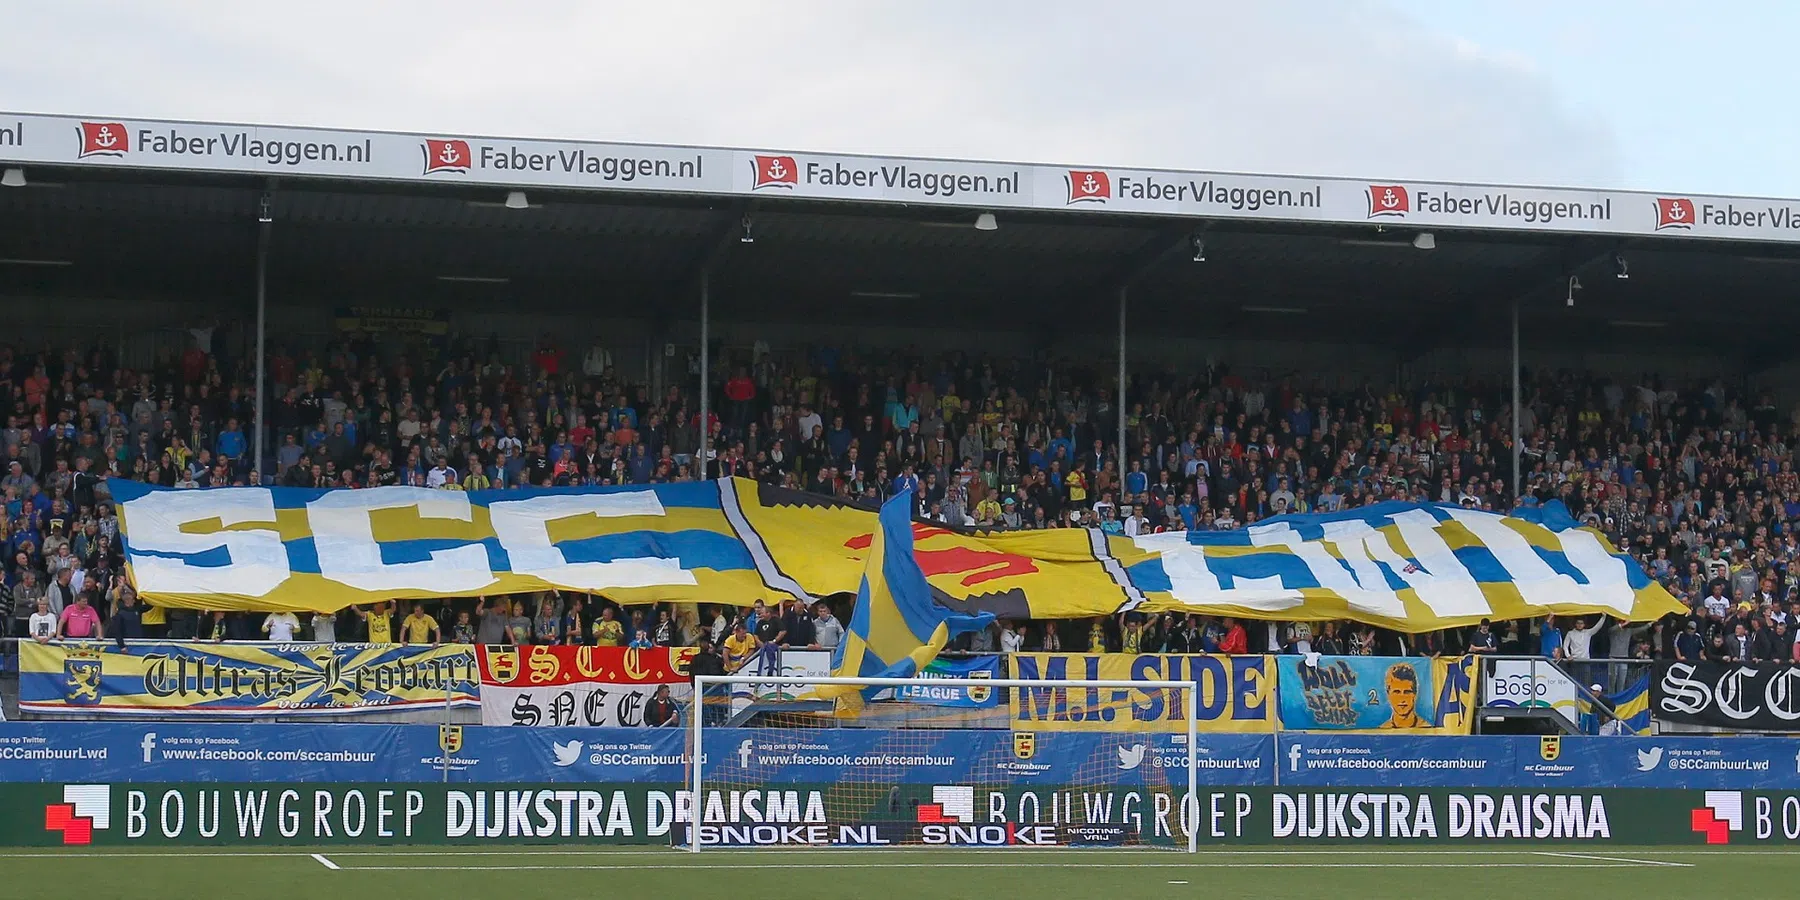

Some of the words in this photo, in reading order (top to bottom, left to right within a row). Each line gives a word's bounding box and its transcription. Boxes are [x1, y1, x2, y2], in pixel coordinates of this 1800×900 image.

[138, 129, 371, 165] FaberVlaggen.nl
[479, 145, 702, 181] FaberVlaggen.nl
[806, 162, 1019, 196] FaberVlaggen.nl
[1117, 177, 1321, 210] FaberVlaggen.nl
[1416, 191, 1612, 223] FaberVlaggen.nl
[123, 486, 698, 596] SCC
[276, 642, 320, 653] Voor
[325, 641, 347, 651] de
[142, 653, 299, 699] Ultras
[902, 685, 960, 700] LEAGUE
[1495, 678, 1547, 696] Boso
[275, 699, 319, 710] Voor
[324, 698, 345, 709] de
[353, 696, 391, 708] stad
[1367, 688, 1380, 707] 2
[22, 736, 46, 744] Twitter
[162, 737, 178, 745] volg
[195, 738, 204, 746] op
[205, 737, 240, 745] Facebook
[588, 743, 604, 751] volg
[758, 743, 773, 751] volg
[797, 743, 830, 751] Facebook
[162, 747, 376, 762] www.facebook.com/sccambuur
[1152, 747, 1164, 755] volg
[1306, 748, 1320, 756] volg
[1668, 749, 1681, 757] volg
[758, 753, 954, 766] www.facebook.com/sccambuur
[1008, 762, 1051, 770] Cambuur
[1152, 756, 1260, 769] @SCCmbuurLwd
[1306, 757, 1487, 770] www.facebook.com/sccambuur
[1668, 758, 1769, 771] @SCCambuurLwd
[127, 788, 424, 838] BOUWGROEP
[446, 790, 634, 837] DIJKSTRA
[1272, 792, 1437, 838] DIJKSTRA
[1449, 793, 1611, 838] DRAISMA
[1756, 796, 1800, 839] BO
[922, 822, 1058, 845] SNOKE
[1067, 827, 1125, 835] NICOTINE-
[1083, 834, 1109, 842] VRIJ
